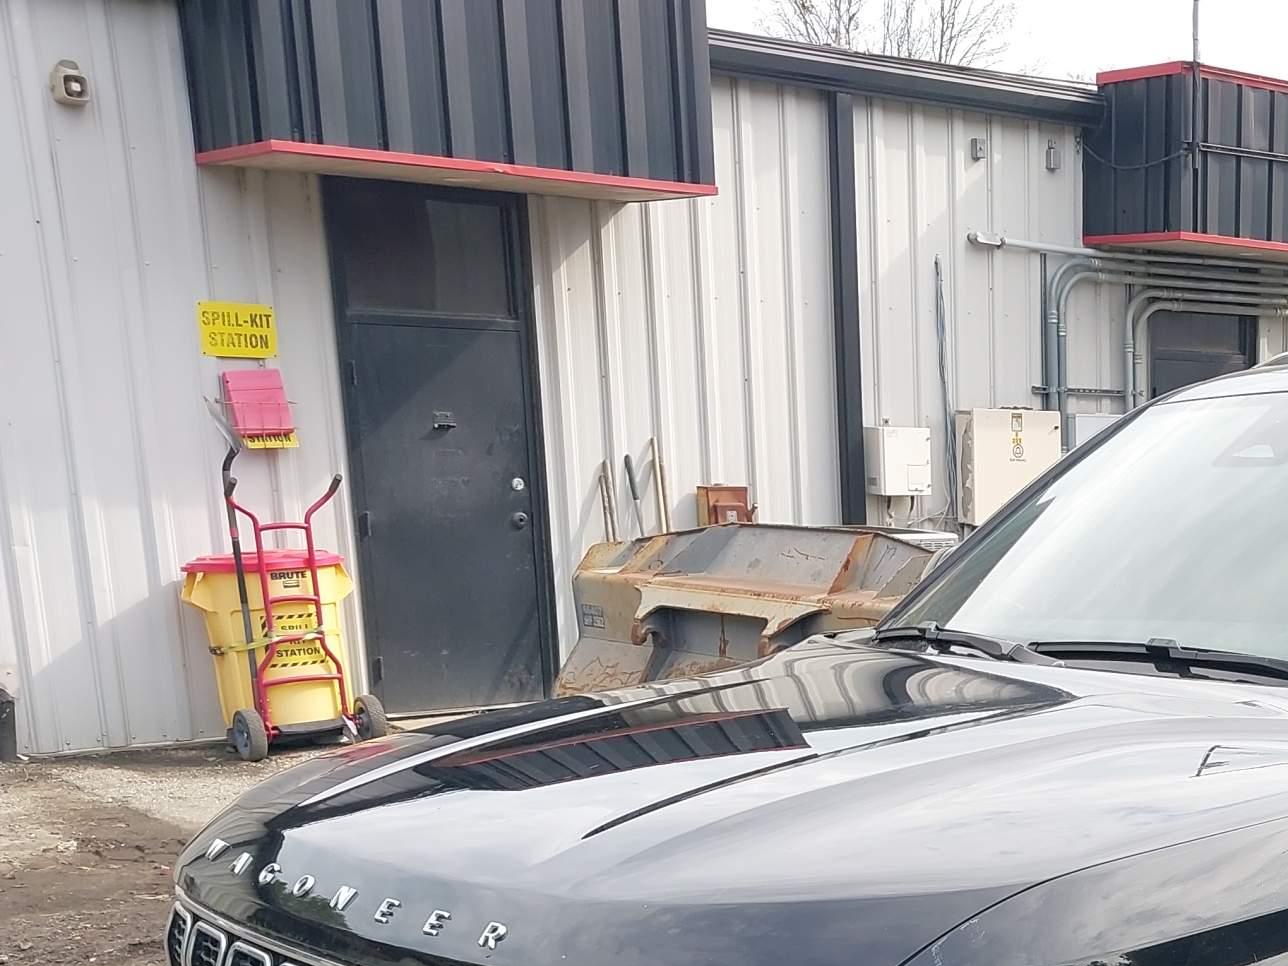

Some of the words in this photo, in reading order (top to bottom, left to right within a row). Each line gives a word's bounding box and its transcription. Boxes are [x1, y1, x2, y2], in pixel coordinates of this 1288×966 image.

[201, 310, 272, 329] SPILL-KIT
[208, 331, 269, 349] STATION
[270, 570, 307, 581] BRUTE
[276, 646, 321, 658] STATION
[204, 838, 508, 951] WAGONEER
